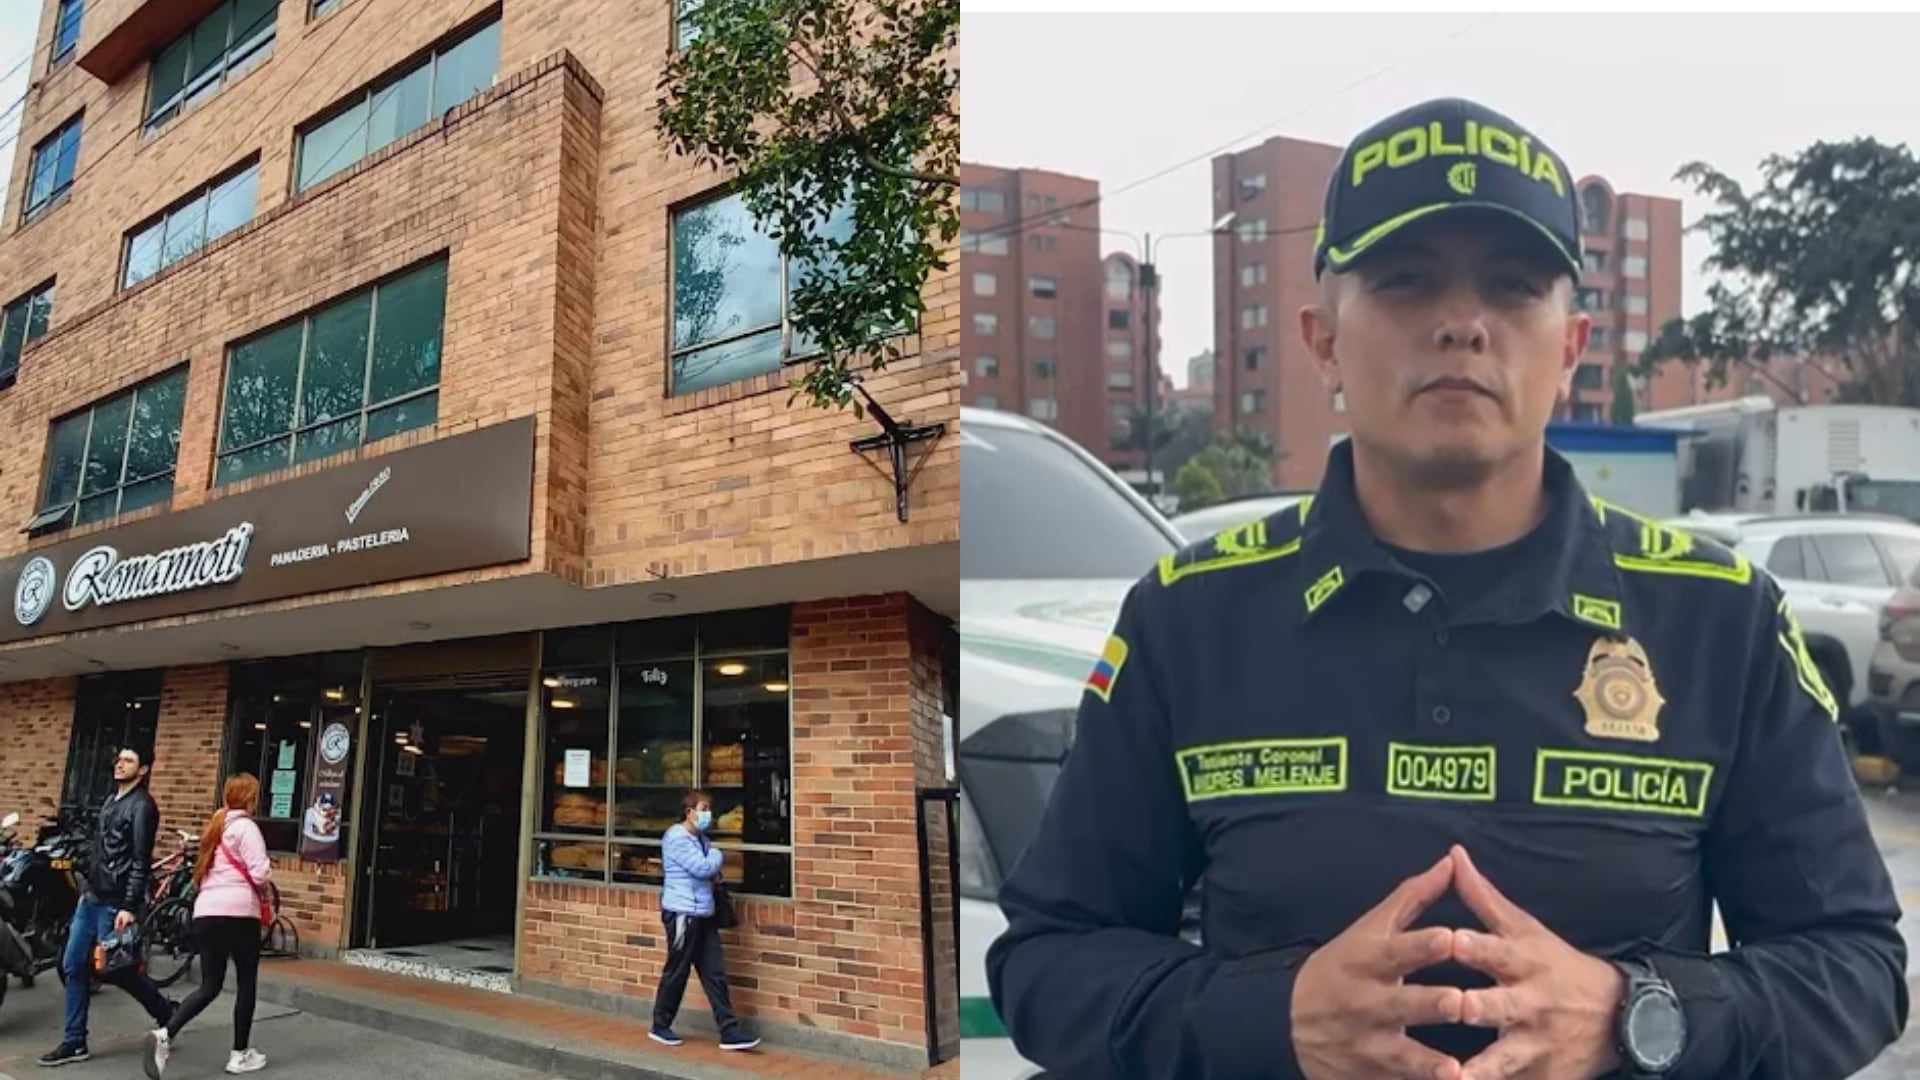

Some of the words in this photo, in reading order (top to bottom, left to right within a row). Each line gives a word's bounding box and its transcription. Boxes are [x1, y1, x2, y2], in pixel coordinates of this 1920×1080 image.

[1352, 120, 1564, 197] POLICÍA
[270, 543, 330, 567] PANADERIA
[336, 526, 409, 554] PASTELERIA
[1259, 746, 1322, 765] Coronel
[1397, 754, 1488, 789] 004979
[1253, 763, 1336, 787] MELENJE
[1563, 766, 1689, 804] POLICÍA
